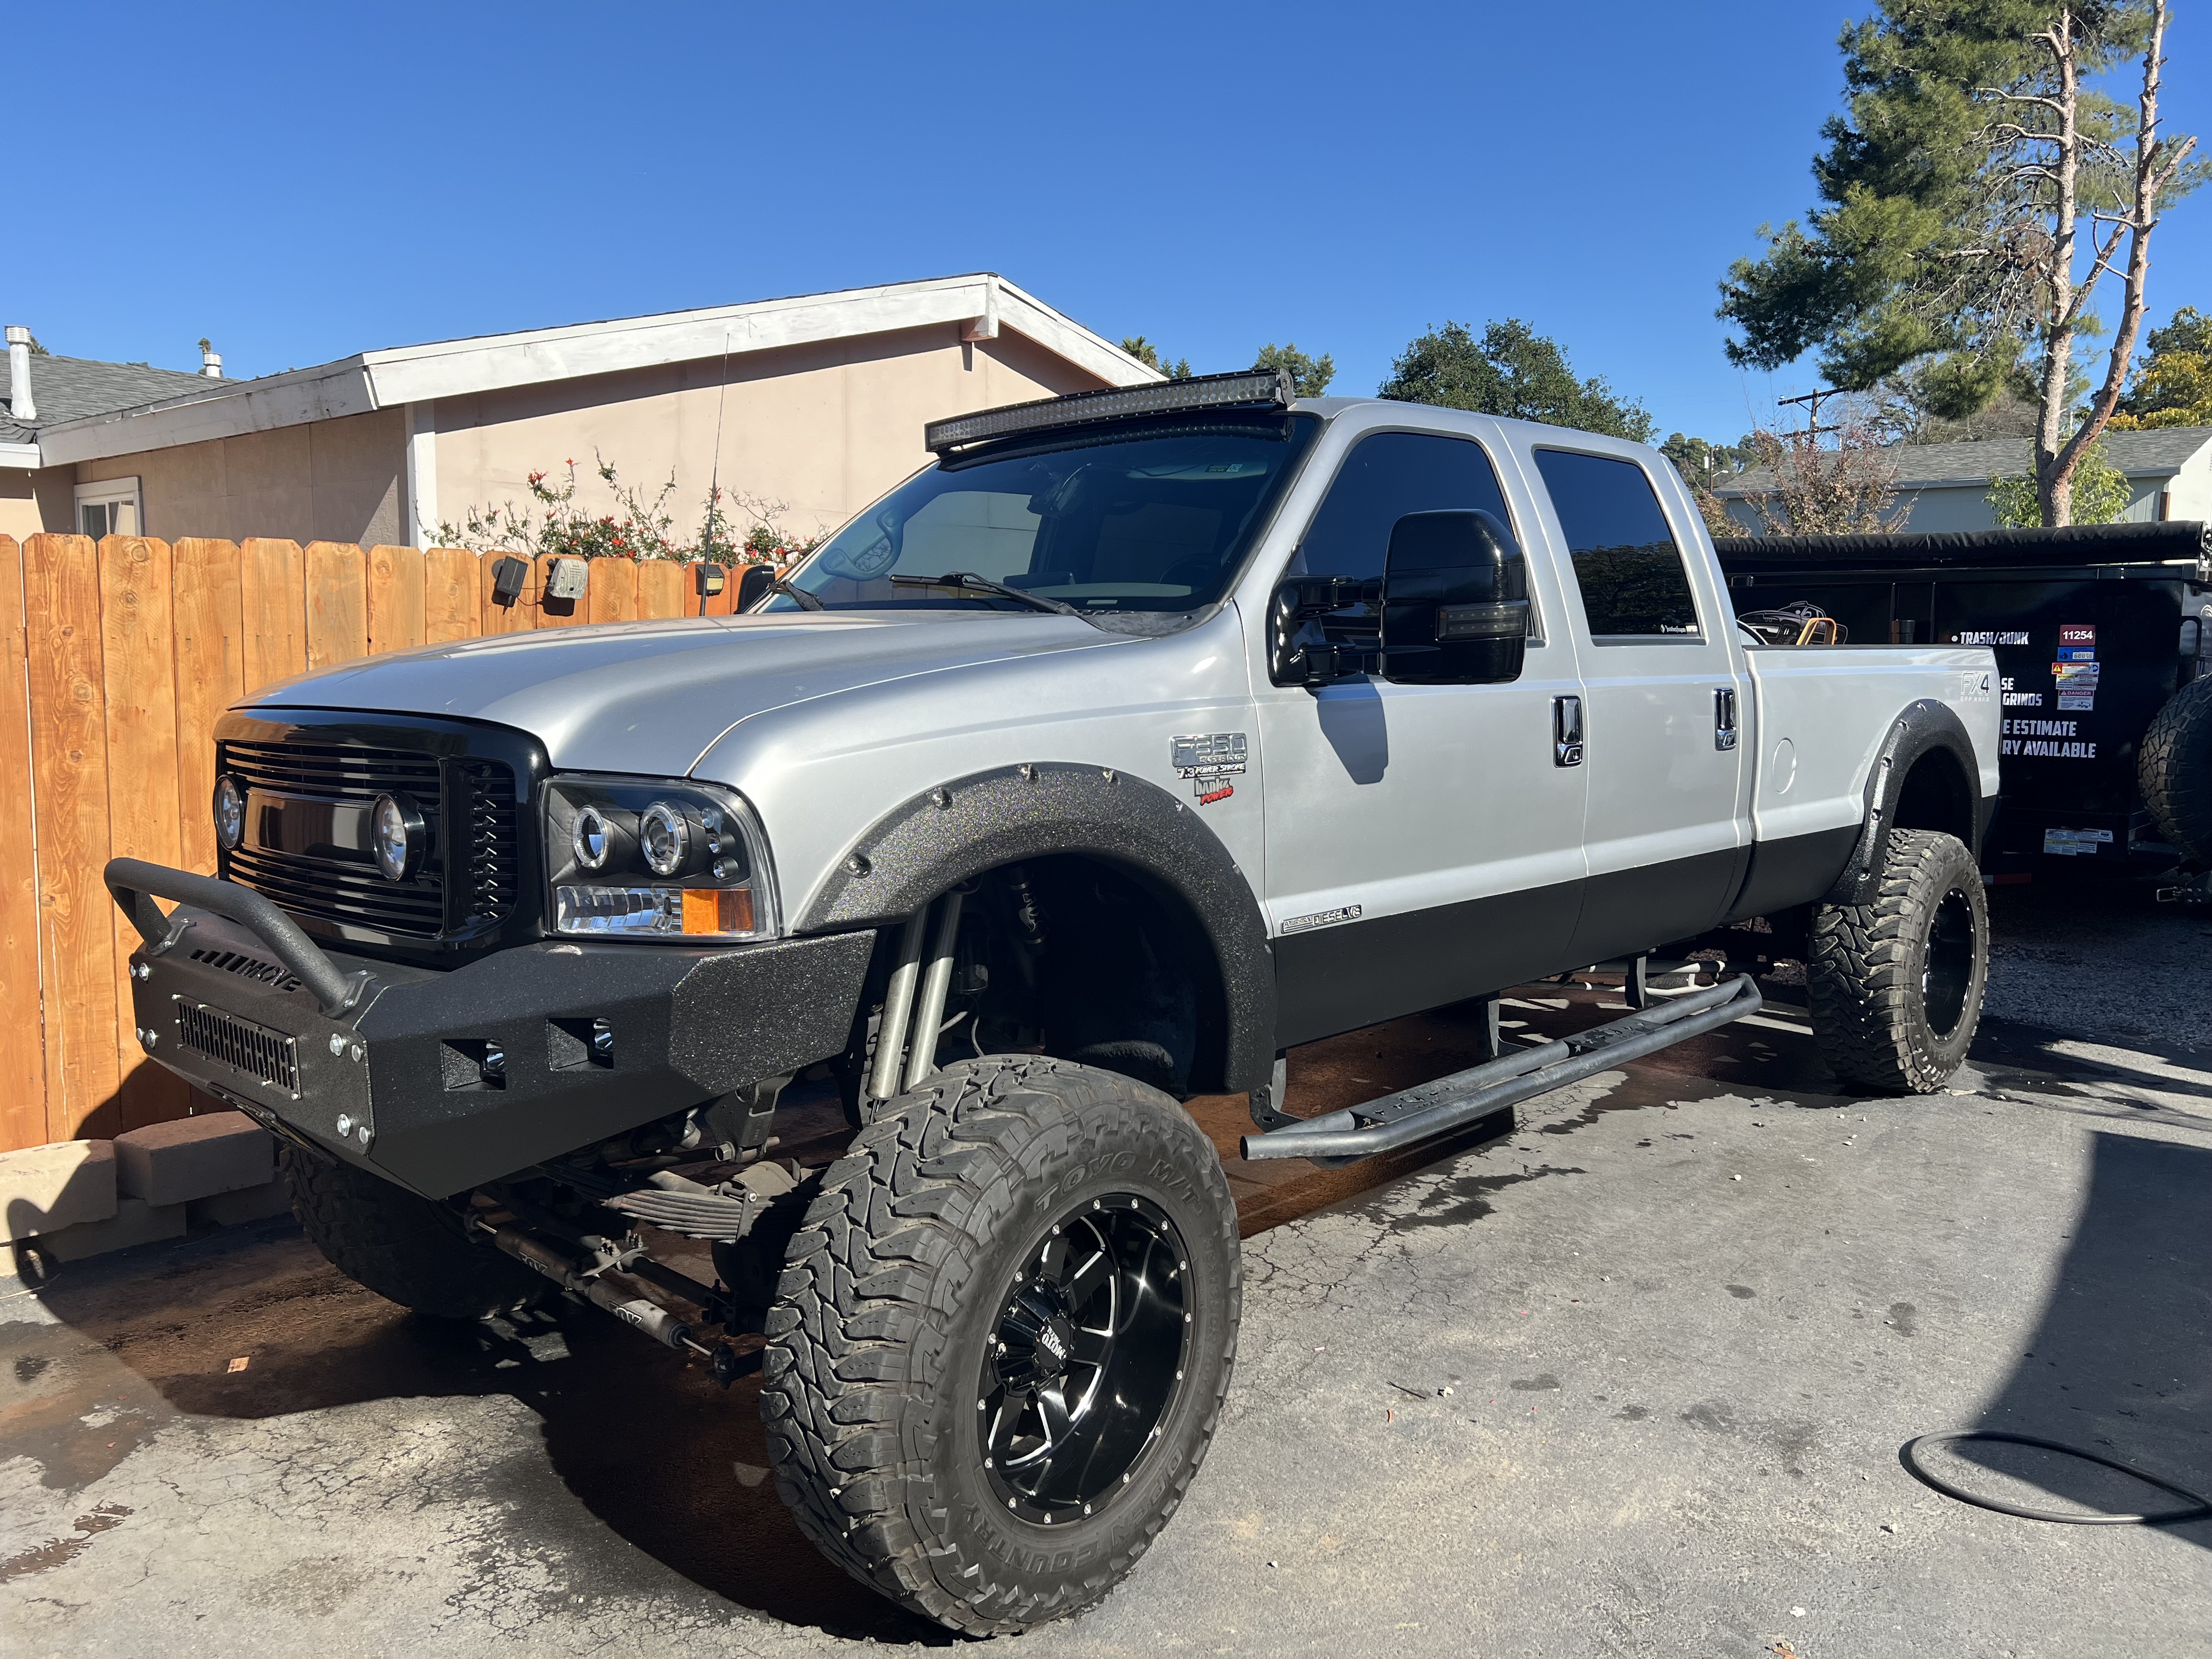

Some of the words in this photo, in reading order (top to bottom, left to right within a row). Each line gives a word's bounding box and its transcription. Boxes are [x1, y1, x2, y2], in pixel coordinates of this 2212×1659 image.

[1960, 631, 2029, 645] TRASH/JUNK
[2063, 631, 2094, 640] 11254
[1960, 671, 1990, 696] FX4
[2002, 693, 2042, 706] GRINDS
[2013, 719, 2077, 736] ESTIMATE
[2023, 741, 2097, 758] AVAILABLE
[1177, 768, 1195, 779] 7.3
[1195, 765, 1218, 774] POWER
[1219, 763, 1245, 772] STROKE
[1200, 786, 1233, 805] POWER
[1313, 909, 1347, 926] DIESEL
[1036, 1151, 1138, 1211] TOYO
[1042, 1333, 1067, 1361] MOTO
